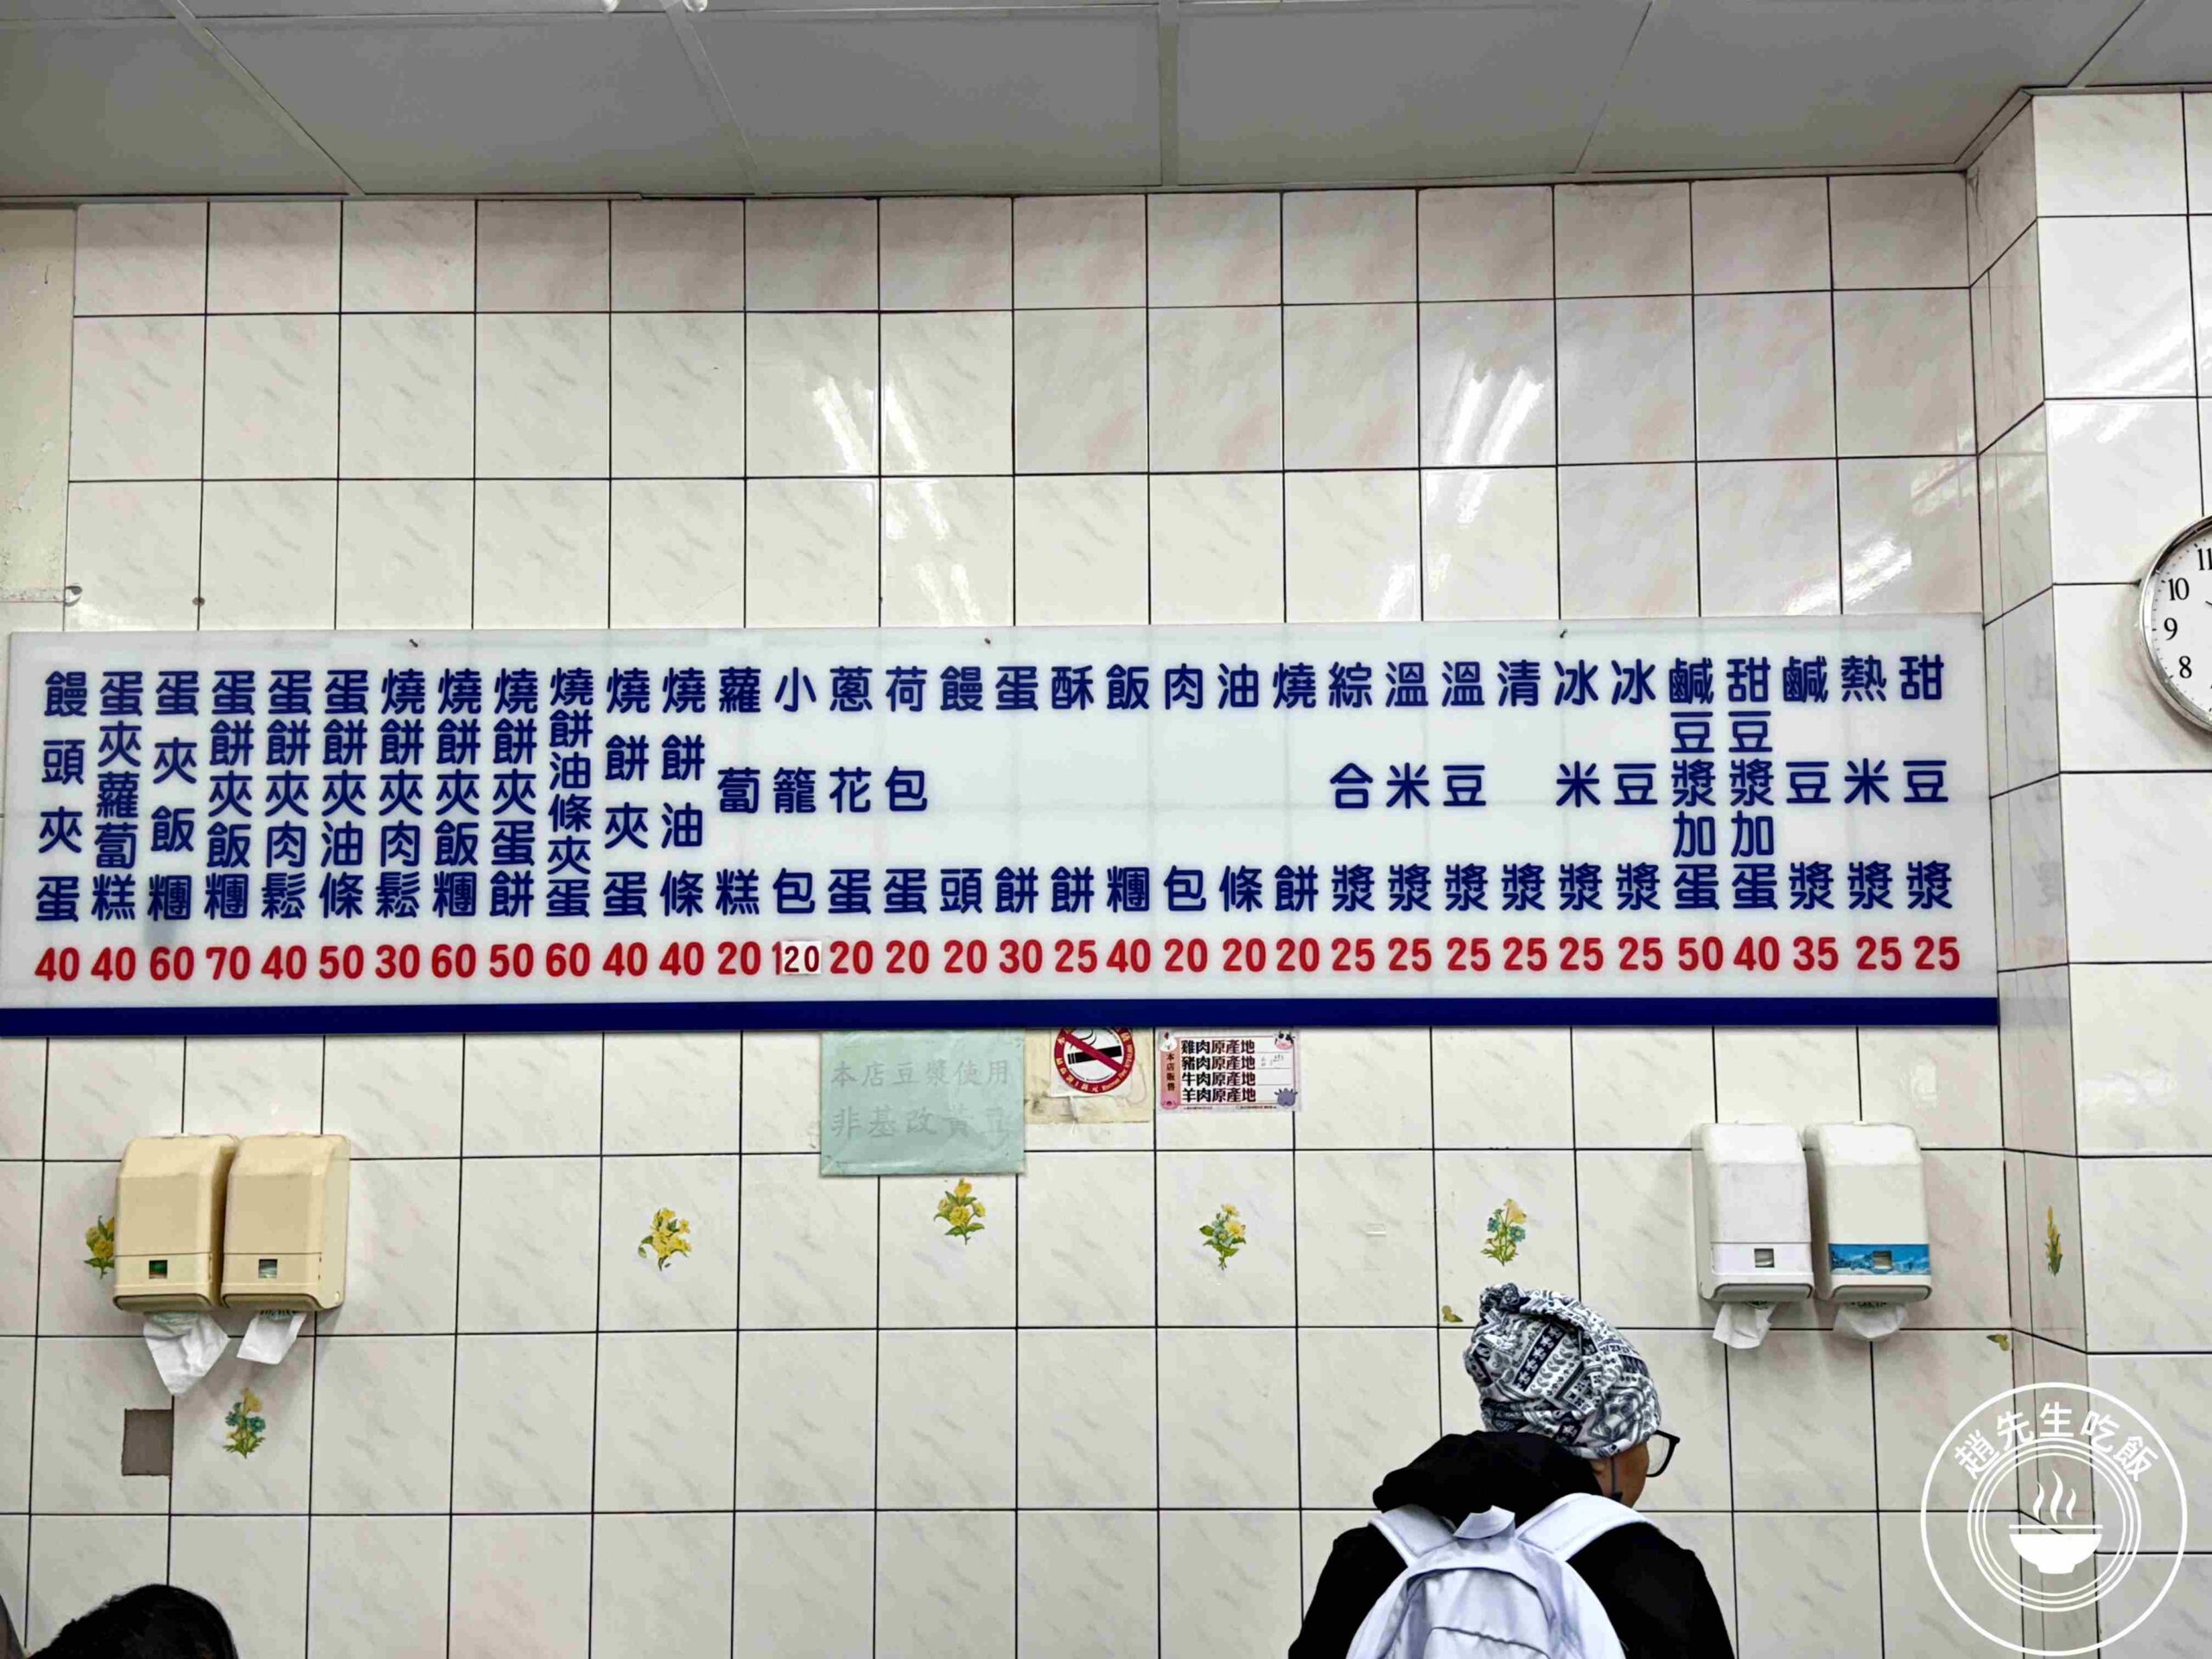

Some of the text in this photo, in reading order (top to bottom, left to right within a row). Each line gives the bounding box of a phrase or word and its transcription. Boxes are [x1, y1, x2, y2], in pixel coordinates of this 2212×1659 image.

[2164, 617, 2177, 640] 9
[2168, 577, 2190, 601] 10
[2178, 656, 2192, 678] 8
[36, 671, 88, 922] 饅頭夾蛋
[92, 671, 143, 921] 蛋夾蘿蔔糕
[149, 670, 200, 920] 蛋夾飯糰
[206, 670, 257, 919] 蛋餅夾飯糰
[262, 670, 313, 919] 蛋餅夾肉鬆
[319, 669, 370, 918] 蛋餅夾油條
[376, 670, 426, 918] 燒餅夾肉鬆
[433, 669, 482, 918] 燒餅夾飯糰
[489, 669, 538, 918] 燒餅夾蛋餅
[547, 667, 594, 918] 燒餅油條夾蛋
[604, 668, 651, 917] 燒餅夾蛋
[659, 667, 706, 916] 燒餅油條
[715, 667, 761, 914] 蘿蔔糕
[772, 667, 817, 914] 小籠包
[884, 666, 928, 914] 荷包蛋
[939, 665, 983, 913] 饅頭
[995, 665, 1039, 913] 蛋餅
[1051, 665, 1095, 913] 酥餅
[1105, 664, 1150, 913] 飯糰
[1164, 664, 1207, 912] 肉包
[1218, 663, 1263, 912] 油條
[1272, 663, 1319, 912] 燒餅
[1328, 662, 1375, 912] 綜合漿
[1386, 662, 1432, 912] 溫米漿
[1442, 661, 1489, 912] 溫豆漿
[1497, 659, 1545, 912] 清漿
[1554, 660, 1602, 912] 冰米漿
[1611, 658, 1660, 911] 冰豆漿
[1669, 658, 1719, 911] 鹹豆漿加蛋
[1727, 657, 1778, 910] 甜豆漿加蛋
[1783, 656, 1834, 911] 鹹豆漿
[1841, 656, 1893, 910] 熱米漿
[1899, 653, 1950, 910] 甜豆漿
[35, 935, 1961, 982] 40 40 60 70 40 50 30 60 50 60 40 40 20 120 20 20 20 30 25 40 20 20 20 25 25 25 25 25 25 50 40 35 25 25
[1181, 1039, 1255, 1054] 雞肉原產地
[1181, 1055, 1255, 1071] 豬肉原產地
[1182, 1071, 1255, 1086] 牛肉原產地
[1182, 1087, 1256, 1103] 羊肉原產地
